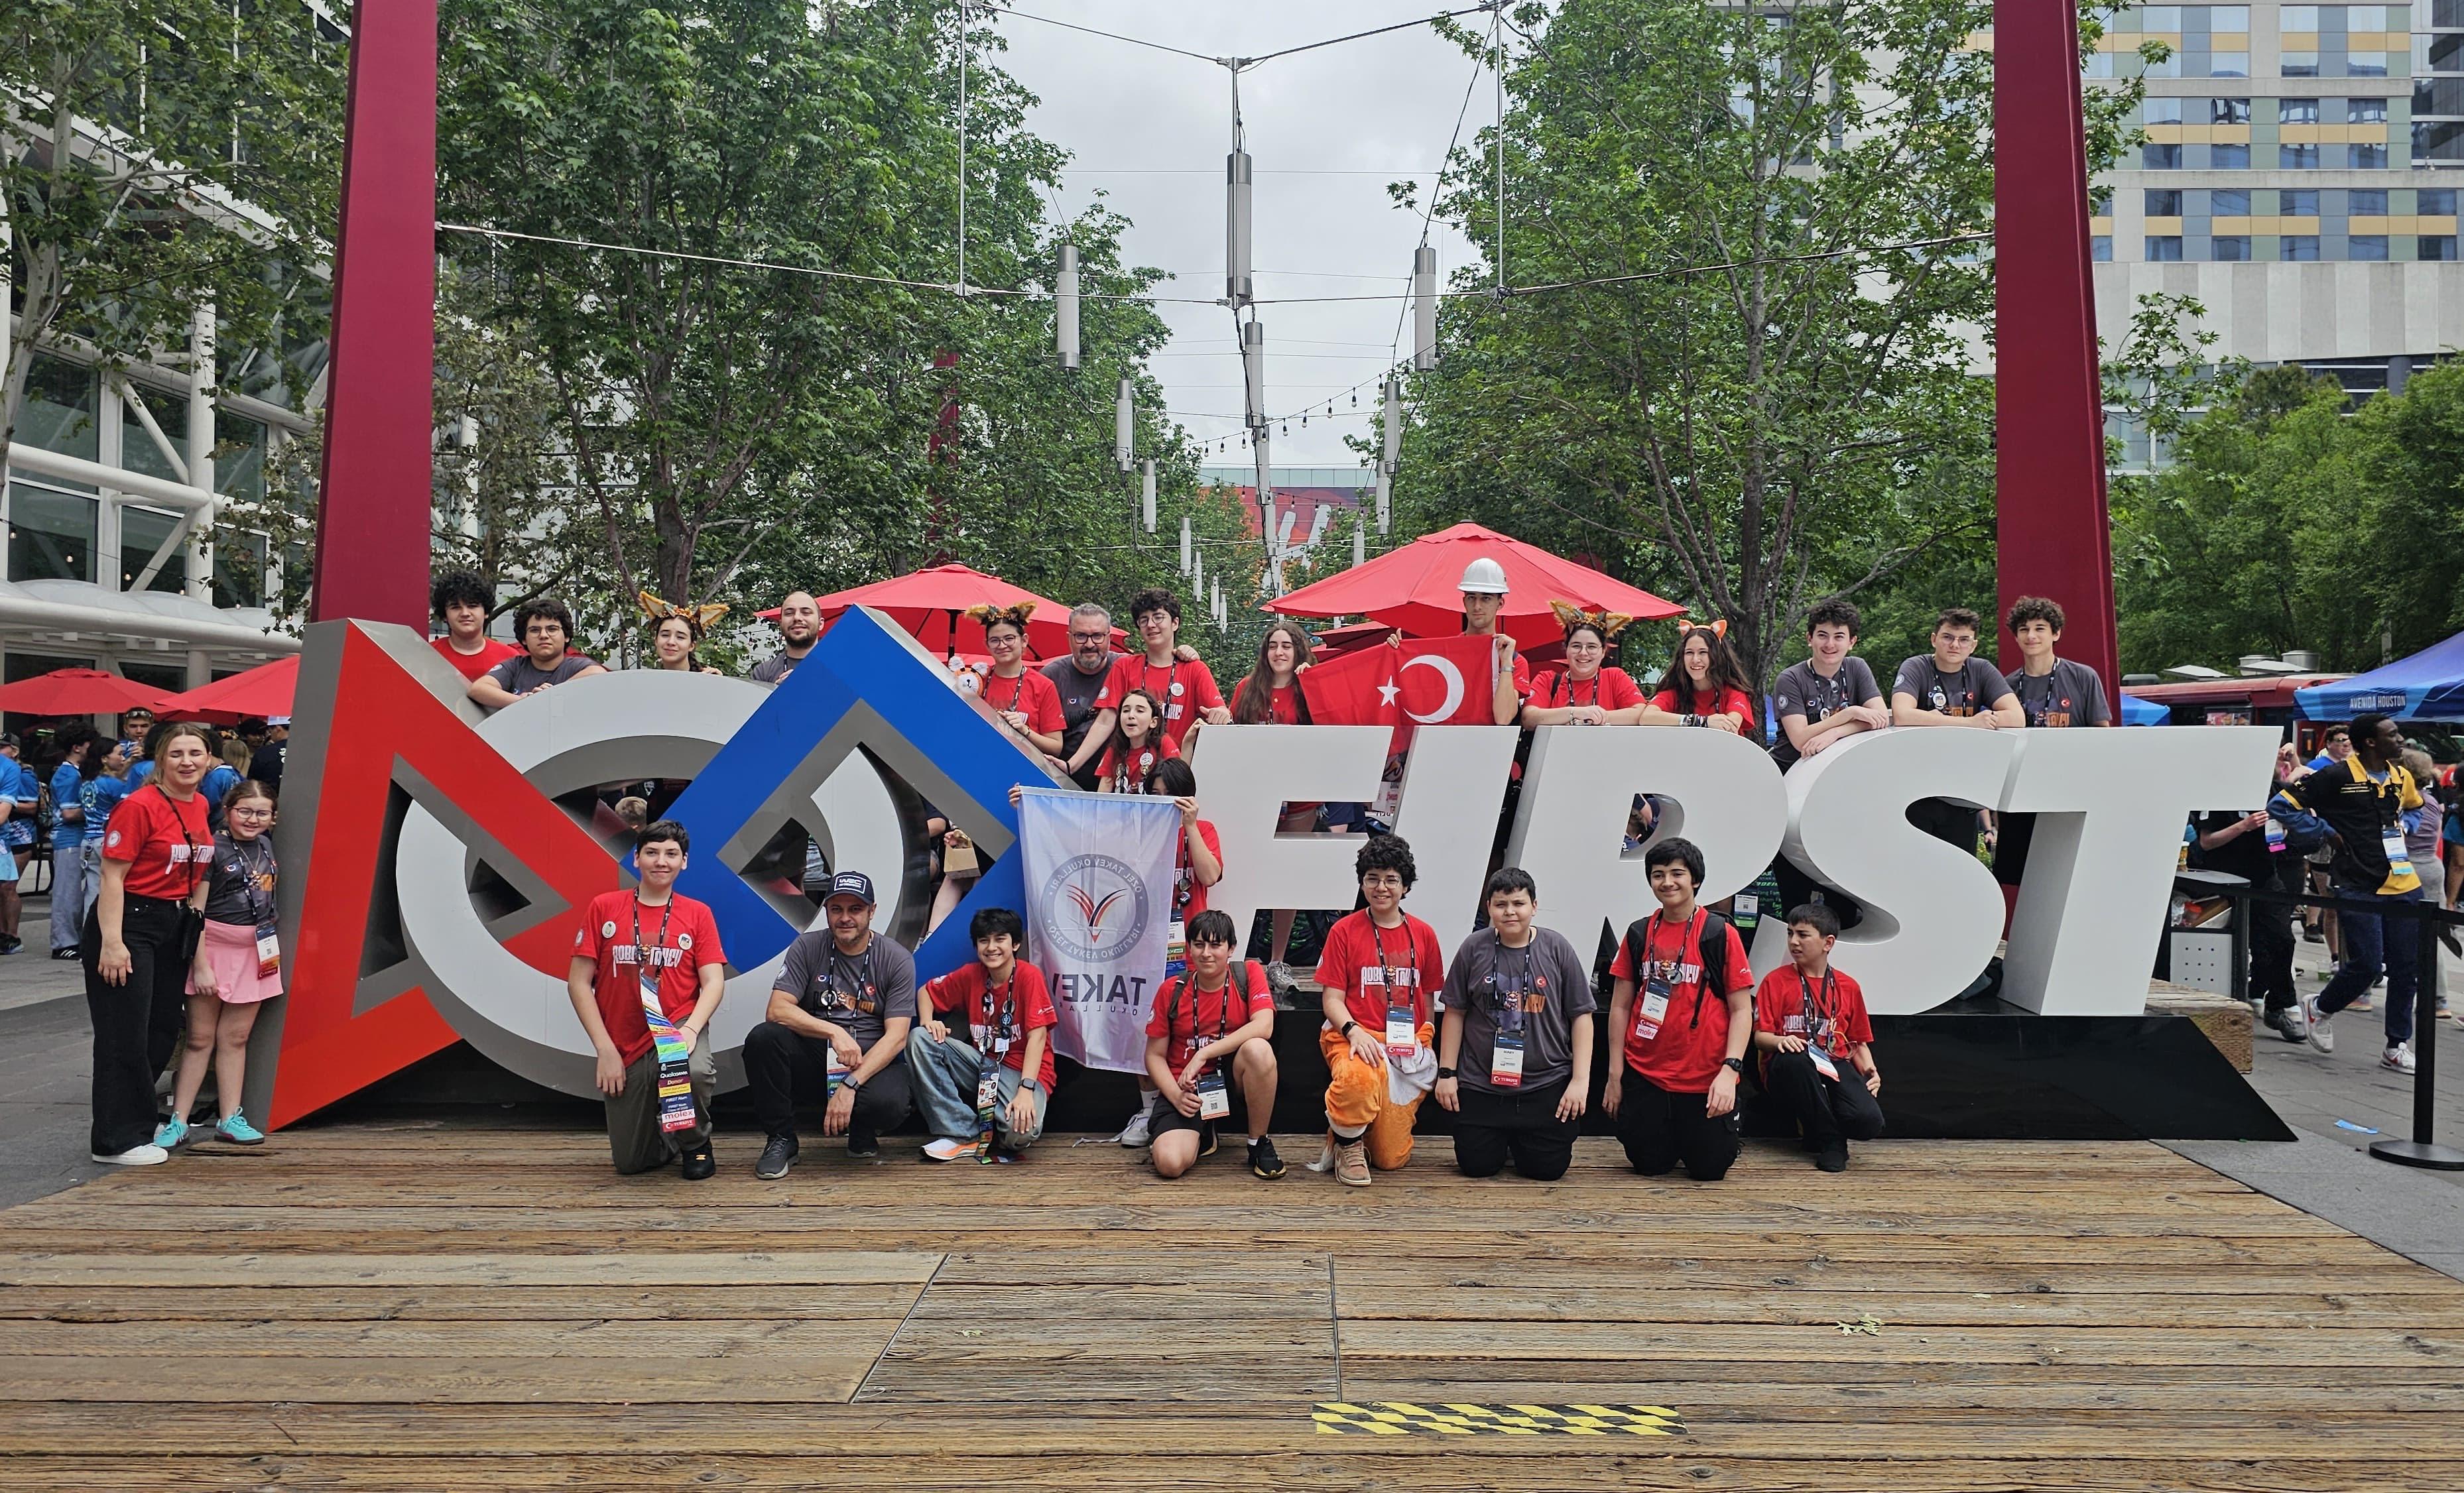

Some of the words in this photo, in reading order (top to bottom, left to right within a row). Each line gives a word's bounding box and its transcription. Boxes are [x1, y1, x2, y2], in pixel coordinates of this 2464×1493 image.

[2349, 696, 2376, 709] AVENIDA
[2377, 695, 2406, 707] HOUSTON
[1192, 725, 2282, 1016] FIRST
[664, 1110, 693, 1119] molex
